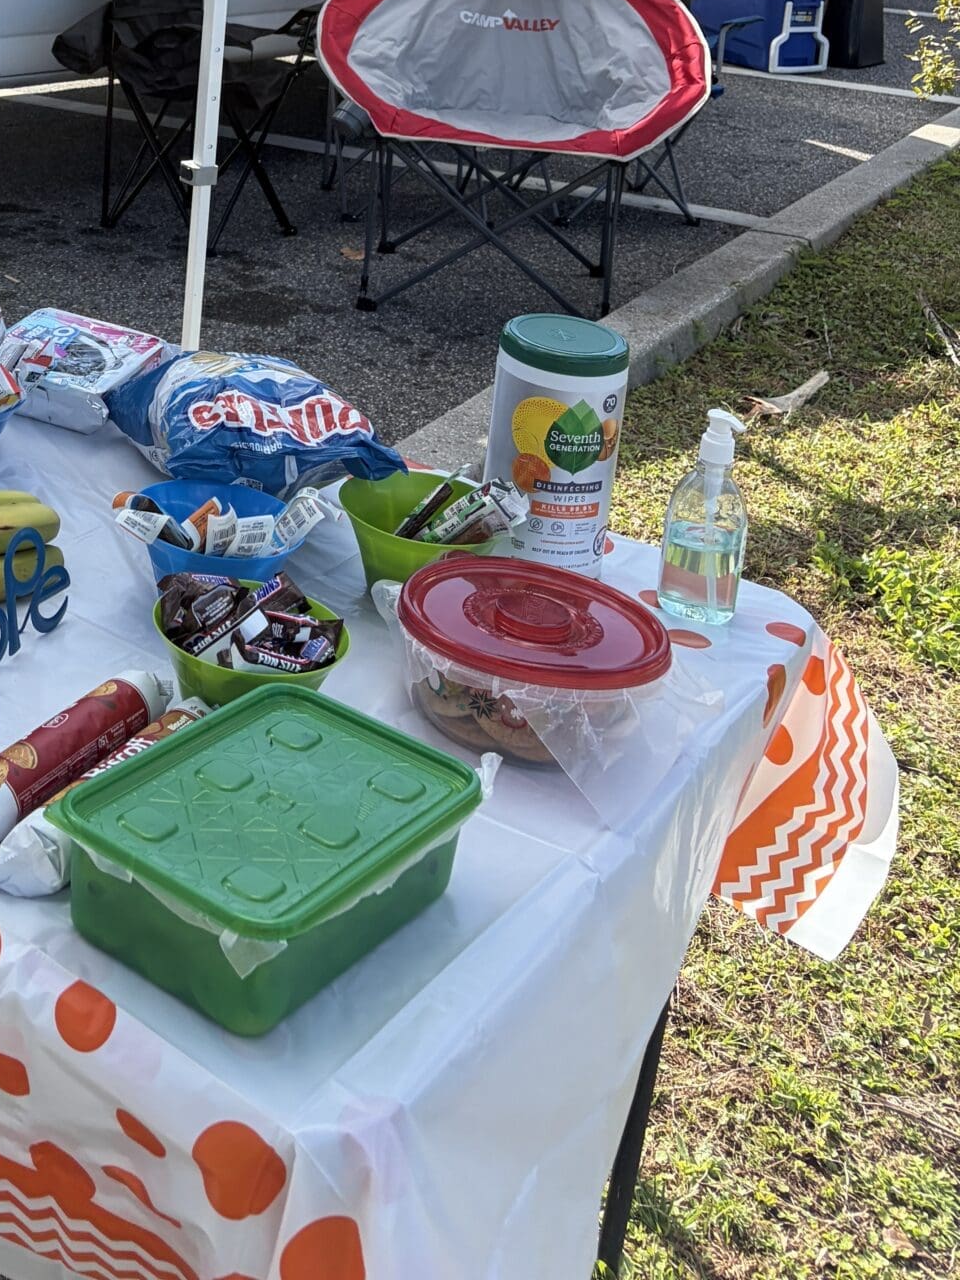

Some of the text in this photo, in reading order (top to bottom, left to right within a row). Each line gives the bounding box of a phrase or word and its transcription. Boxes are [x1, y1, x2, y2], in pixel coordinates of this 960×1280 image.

[606, 397, 616, 408] 70
[550, 430, 601, 444] Seventh
[549, 443, 601, 453] GENERATION
[536, 482, 600, 492] DISINFECTING
[553, 495, 586, 503] WIPES
